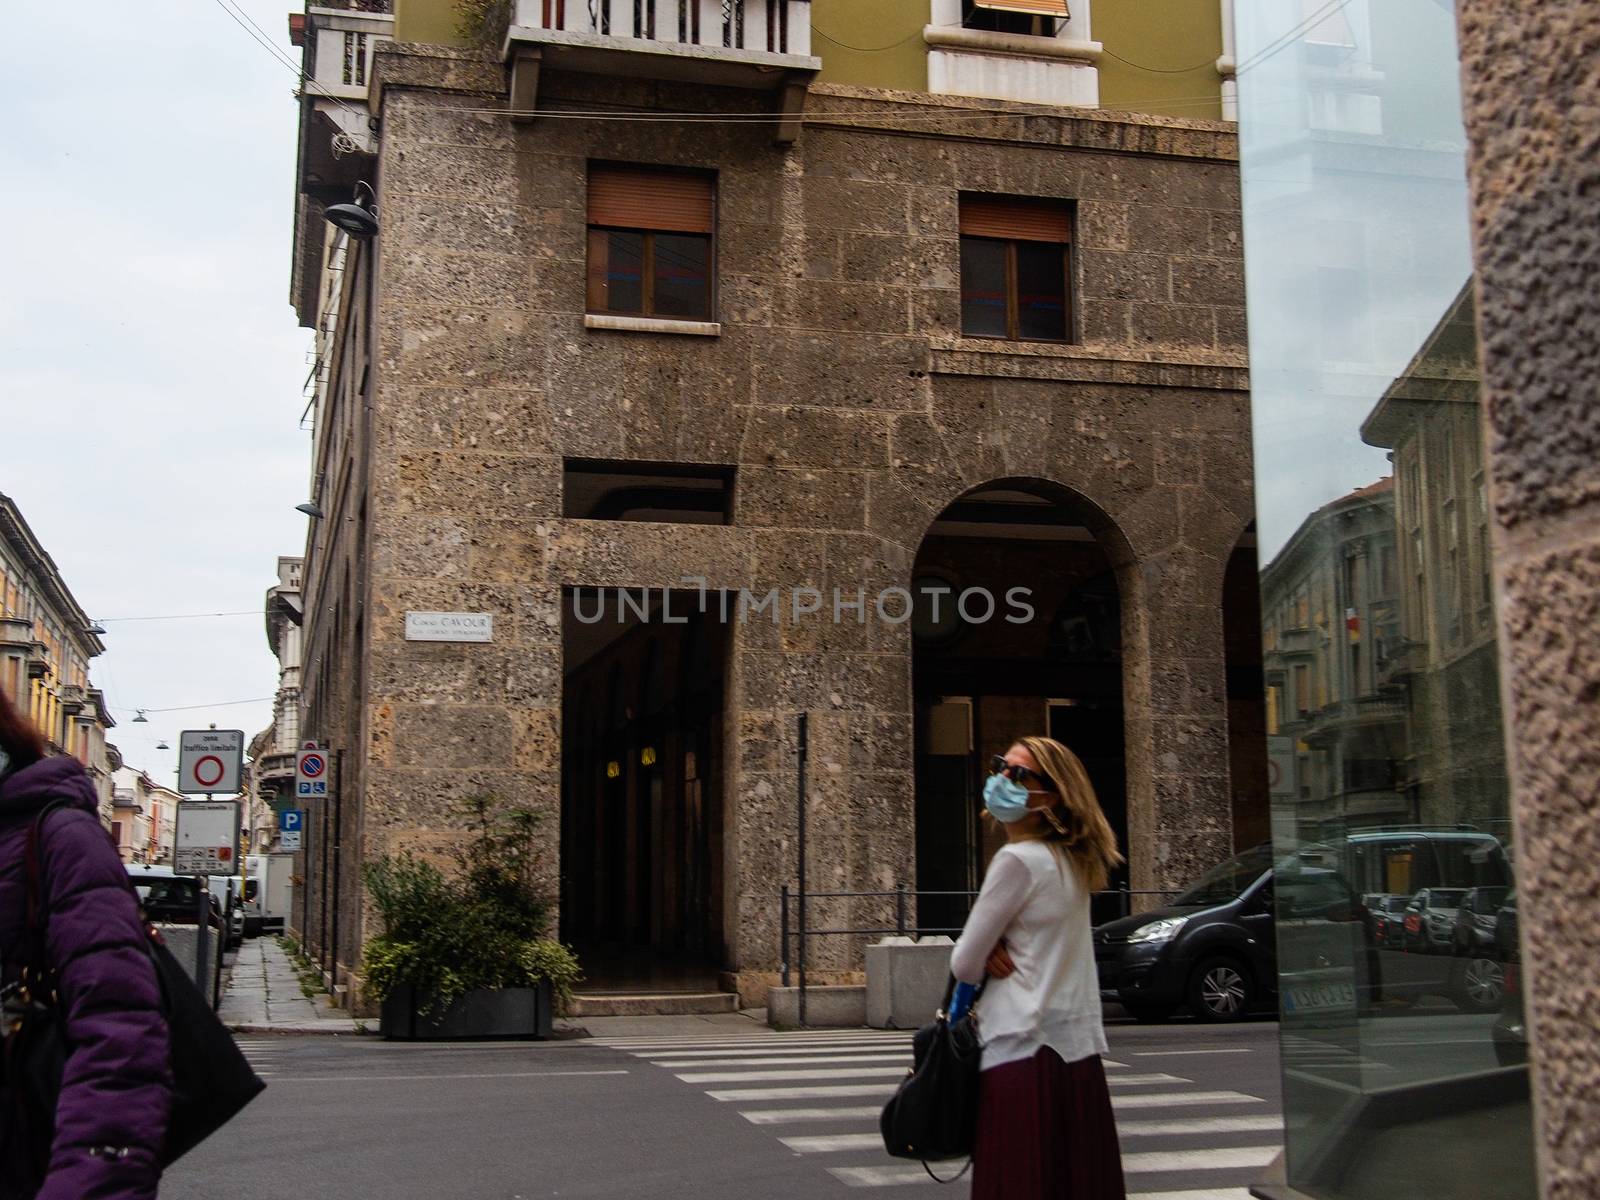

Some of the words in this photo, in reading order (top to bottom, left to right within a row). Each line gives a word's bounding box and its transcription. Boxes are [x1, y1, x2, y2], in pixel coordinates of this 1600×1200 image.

[441, 617, 487, 627] CAVOUR
[183, 744, 209, 752] traffico
[211, 744, 237, 752] limitato
[285, 813, 298, 829] P
